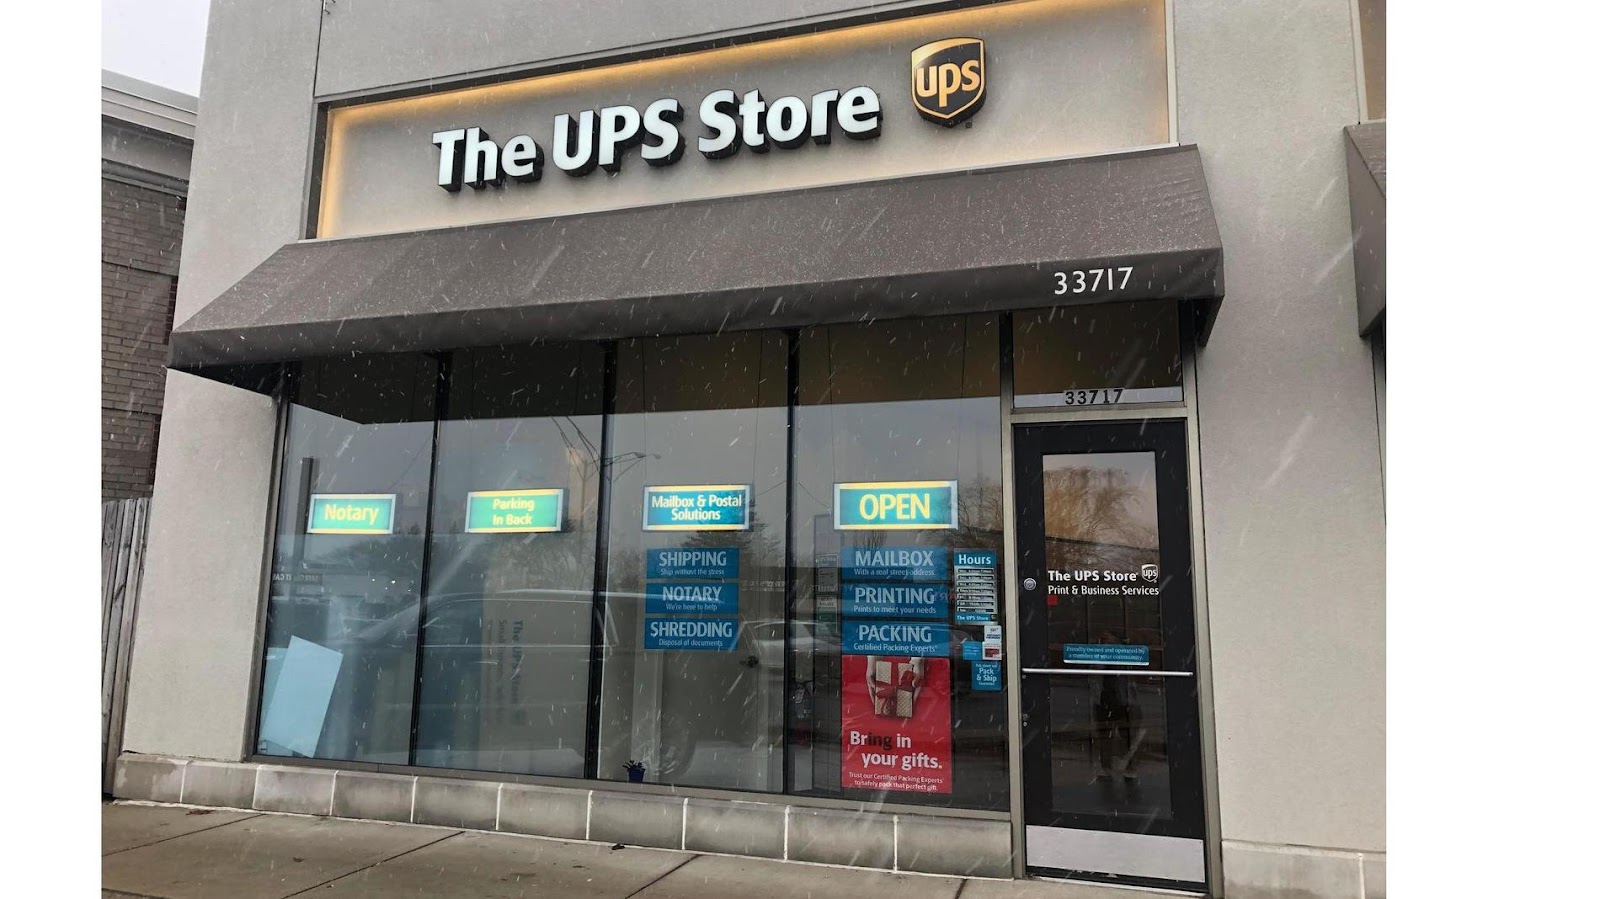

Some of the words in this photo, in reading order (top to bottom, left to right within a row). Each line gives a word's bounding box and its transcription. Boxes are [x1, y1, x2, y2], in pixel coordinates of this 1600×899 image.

[915, 60, 980, 108] ups
[432, 126, 541, 188] The
[552, 98, 682, 172] UPS
[698, 85, 881, 154] Store
[1054, 266, 1134, 295] 33717
[1065, 388, 1123, 405] 33717
[493, 497, 535, 512] Parking
[651, 494, 695, 508] Mailbox
[697, 494, 706, 507] &
[709, 493, 742, 507] Postal
[859, 493, 930, 520] OPEN
[324, 503, 379, 525] Notary
[493, 513, 502, 525] In
[506, 513, 533, 525] Back
[671, 507, 721, 521] Solutions
[659, 551, 727, 567] SHIPPING
[855, 550, 934, 567] MAILBOX
[958, 553, 992, 565] Hours
[660, 568, 673, 576] Ship
[674, 568, 697, 576] without
[698, 568, 708, 576] the
[853, 568, 870, 576] With
[1048, 570, 1071, 582] The
[1074, 570, 1100, 582] UPS
[662, 586, 722, 602] NOTARY
[855, 587, 935, 605] PRINTING
[1048, 585, 1070, 595] Print
[1072, 585, 1079, 595] &
[1081, 585, 1120, 595] Business
[1121, 585, 1160, 596] Services
[704, 603, 718, 612] help
[853, 604, 872, 613] Prints
[873, 605, 880, 613] to
[881, 605, 898, 613] meet
[899, 606, 914, 615] your
[916, 606, 937, 614] needs
[650, 621, 733, 638] SHREDDING
[858, 624, 932, 642] PACKING
[659, 638, 682, 647] Disposal
[683, 638, 690, 646] of
[691, 638, 724, 647] documents
[853, 643, 882, 651] Certified
[883, 643, 909, 653] Packing
[977, 673, 981, 681] &
[983, 674, 997, 683] Ship
[979, 667, 994, 675] Pack
[850, 730, 892, 750] Bring
[896, 733, 911, 748] in
[861, 752, 898, 768] your
[902, 752, 943, 771] gifts.
[849, 771, 863, 779] Trust
[863, 772, 873, 780] our
[873, 772, 898, 781] Certified
[898, 774, 920, 784] Packing
[879, 781, 892, 789] pack
[893, 781, 905, 789] that
[905, 782, 927, 791] perfect
